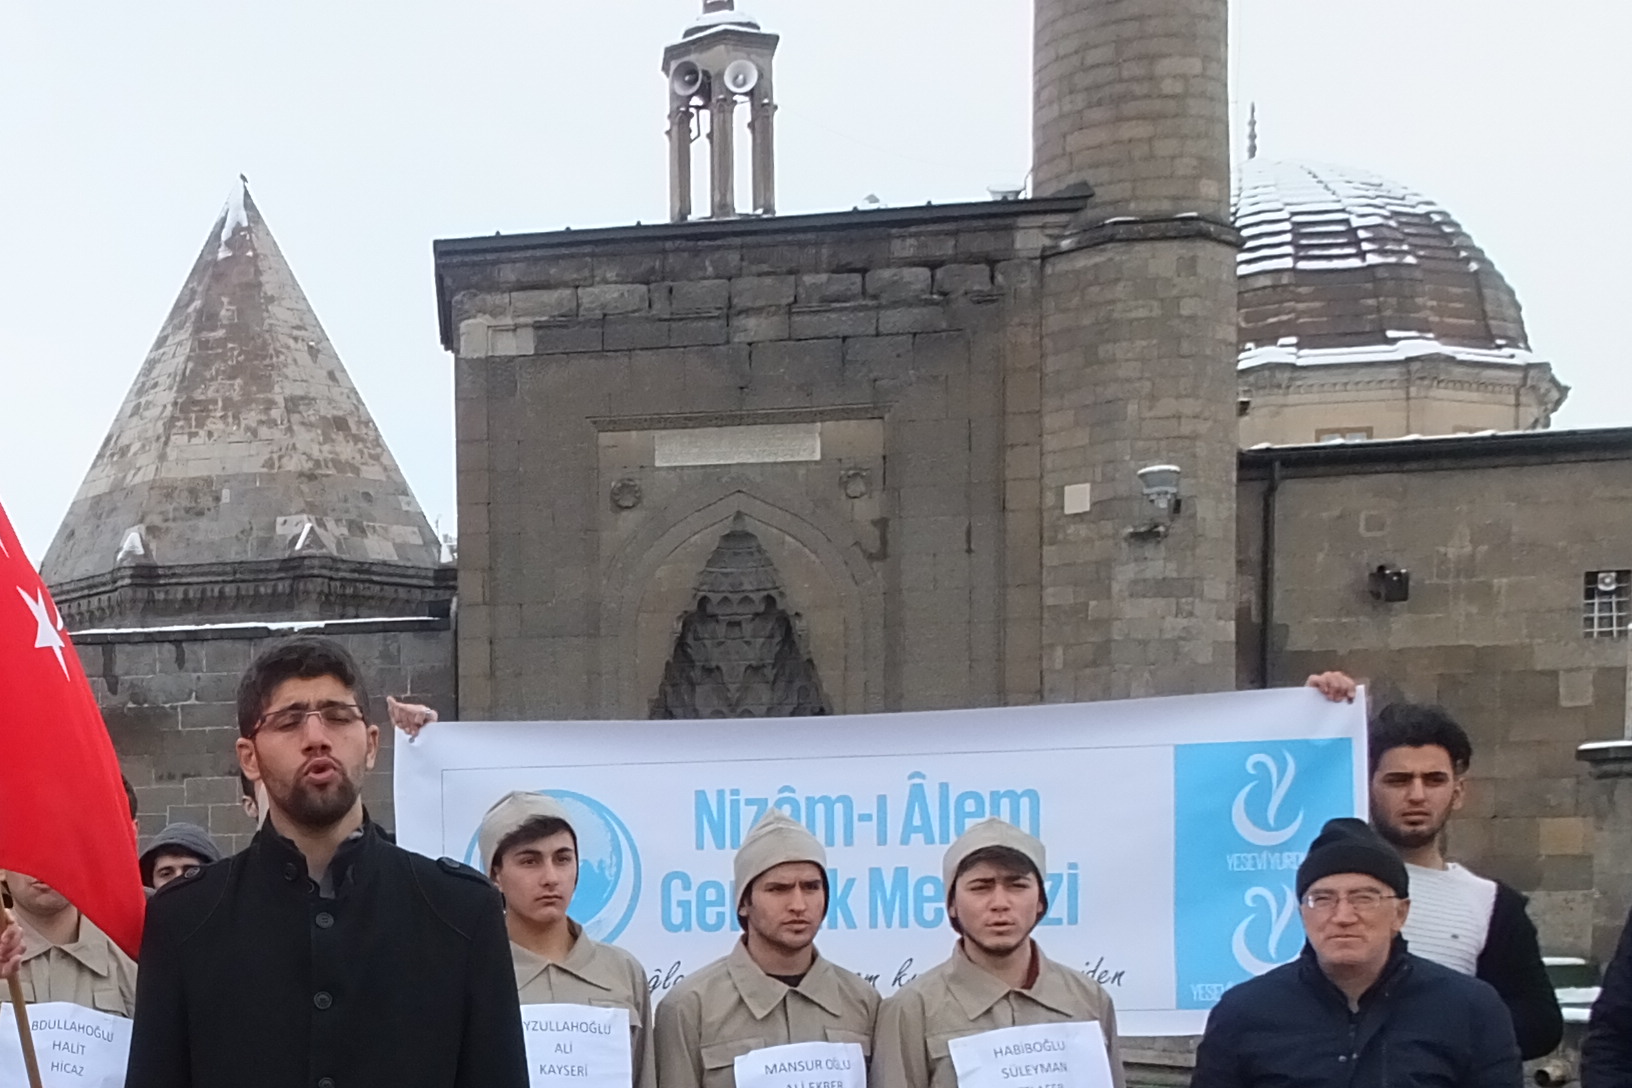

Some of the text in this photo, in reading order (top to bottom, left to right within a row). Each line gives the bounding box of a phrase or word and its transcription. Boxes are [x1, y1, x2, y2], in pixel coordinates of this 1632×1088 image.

[31, 1019, 114, 1043] BDULLAHOĞLU
[52, 1040, 86, 1056] HALİT
[554, 1041, 573, 1054] ALİ
[993, 1038, 1066, 1058] HABİBOĞLU
[50, 1061, 85, 1077] HİCAZ
[539, 1063, 588, 1077] KAYSERİ
[764, 1059, 823, 1075] MANSUR
[1001, 1061, 1068, 1079] SÜLEYMAN
